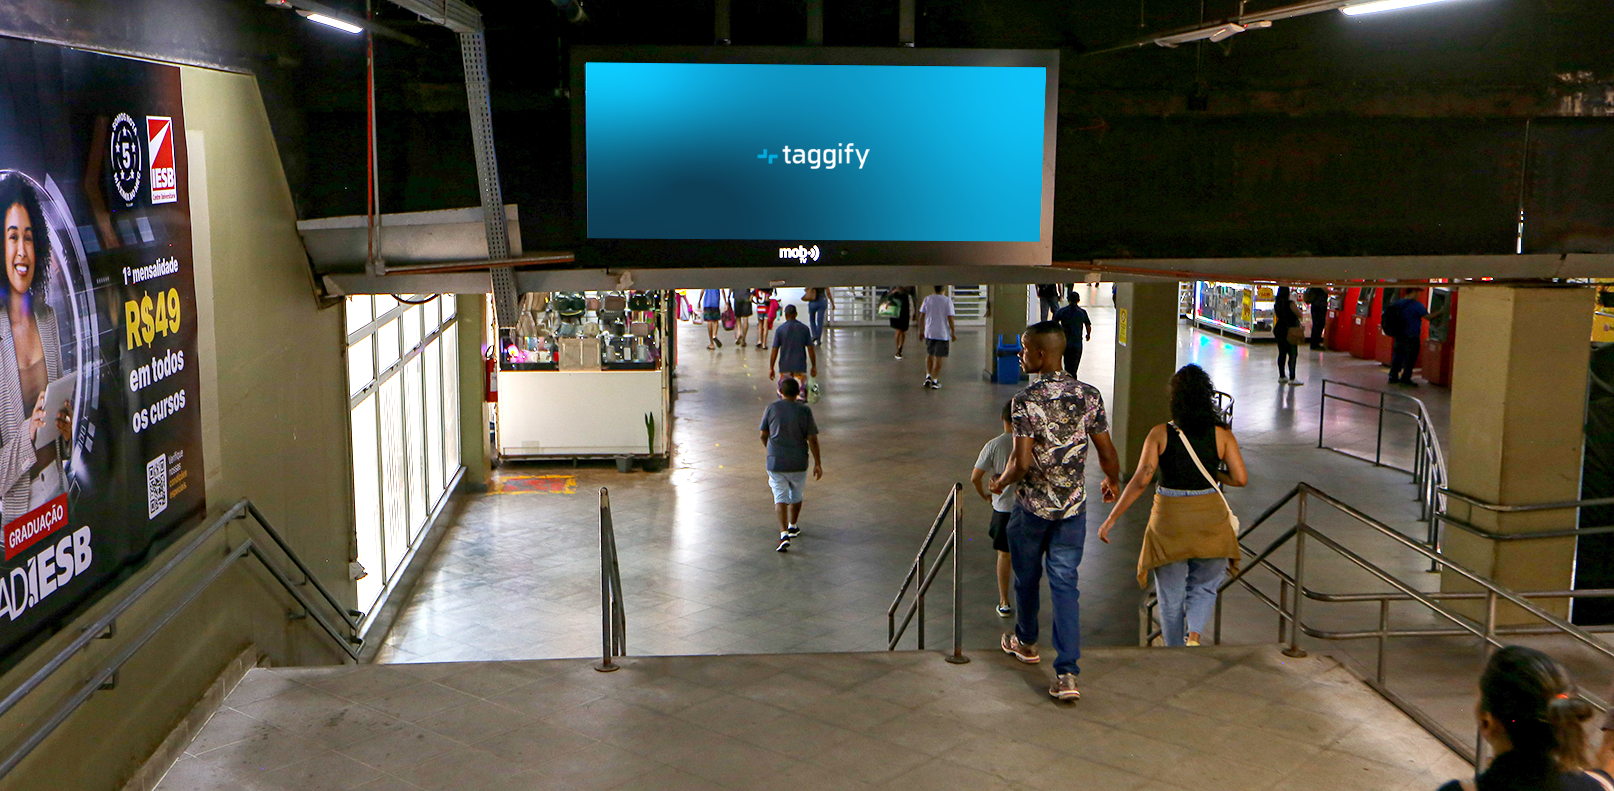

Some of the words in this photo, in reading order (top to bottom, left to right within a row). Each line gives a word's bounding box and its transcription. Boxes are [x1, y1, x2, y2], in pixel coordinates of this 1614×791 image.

[122, 142, 131, 168] 5
[782, 142, 870, 169] taggify
[152, 167, 174, 190] IESB
[132, 256, 178, 284] mensalidade
[124, 288, 180, 350] R$49
[130, 364, 151, 392] em
[151, 348, 184, 382] todos
[132, 408, 149, 434] os
[150, 389, 186, 424] cursos
[9, 504, 64, 548] GRADUAÇÃO
